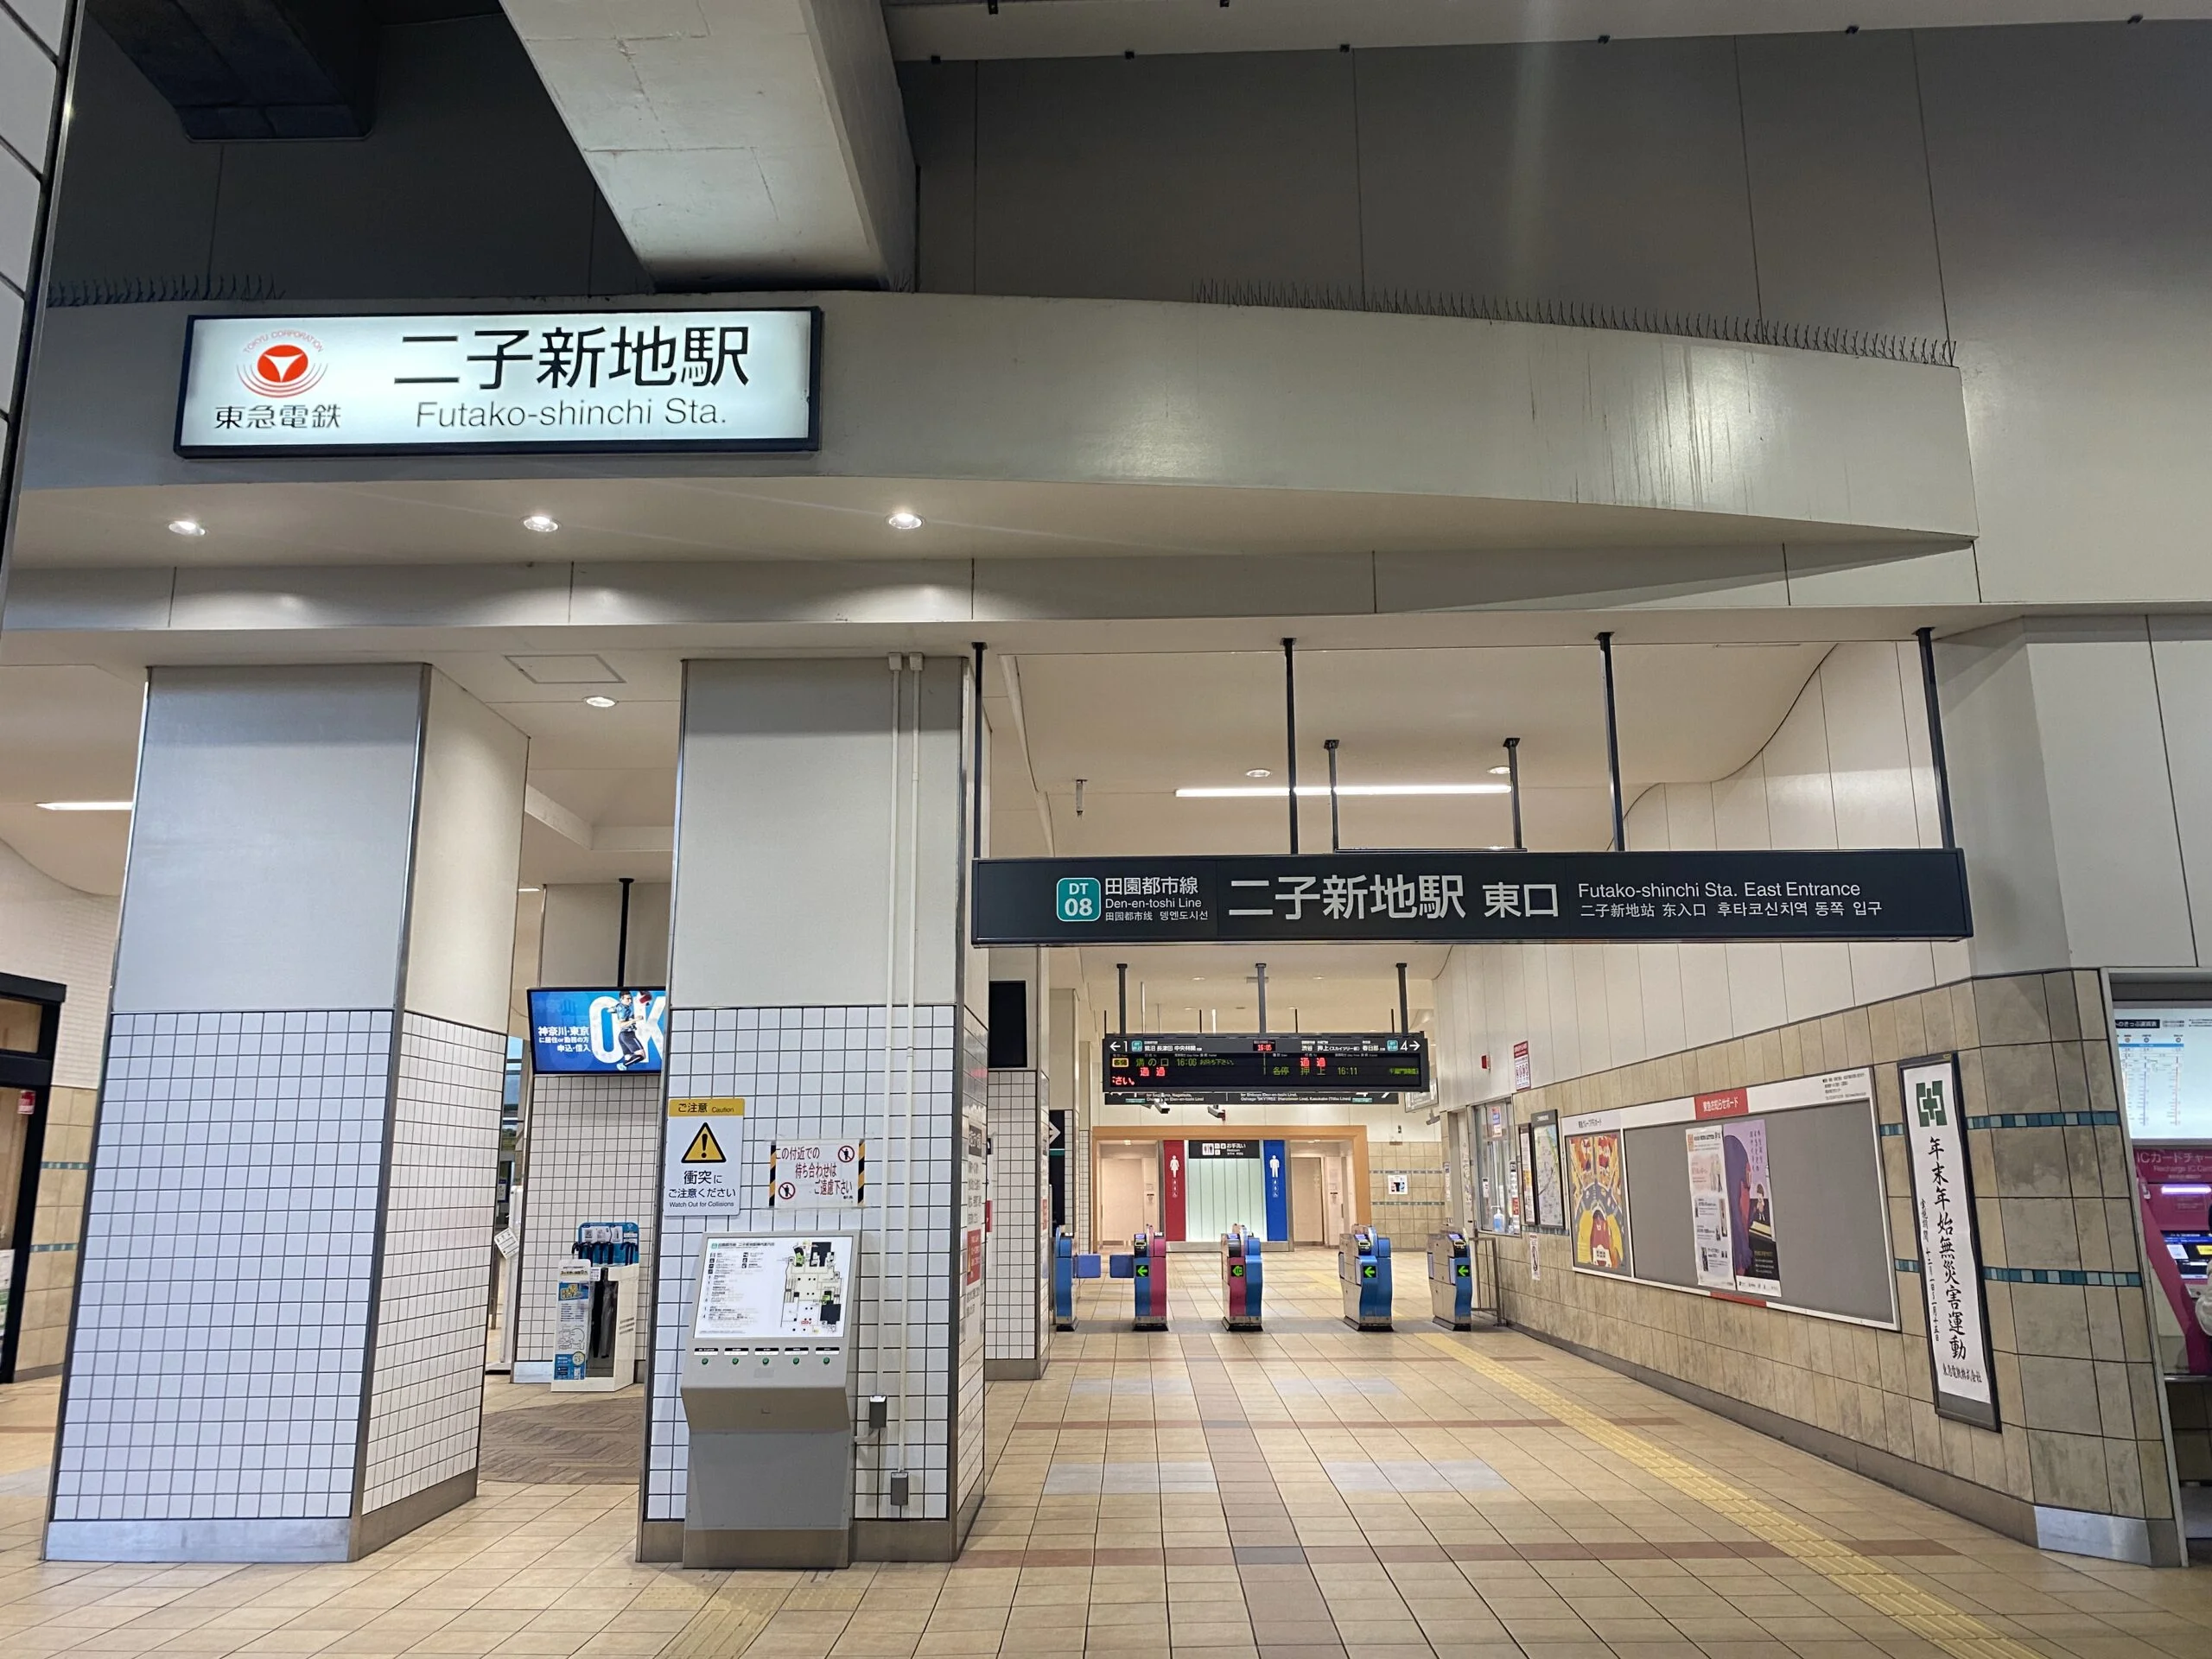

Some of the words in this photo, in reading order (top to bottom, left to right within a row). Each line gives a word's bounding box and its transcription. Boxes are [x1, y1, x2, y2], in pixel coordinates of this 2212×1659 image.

[243, 334, 269, 353] TOKYU
[270, 329, 324, 353] CORPORATION
[394, 326, 750, 391] 二子新地駅
[213, 404, 341, 429] 東急電鉄
[416, 397, 652, 428] Futako-shinchi
[664, 397, 727, 424] Sta.
[1069, 883, 1089, 895] DT
[1104, 876, 1199, 895] 田園都市線
[1578, 882, 1700, 898] Futako-shinchi
[1705, 882, 1738, 897] Sta.
[1745, 882, 1782, 897] East
[1786, 882, 1860, 896] Entrance
[1105, 898, 1175, 909] Den-en-toshi
[1179, 898, 1202, 908] Line
[1229, 874, 1466, 921] 二子新地駅
[1482, 881, 1559, 918] 東口
[1064, 898, 1093, 917] 08
[1580, 903, 1655, 918] 二子新地站
[1662, 903, 1706, 918] 东入口
[1717, 901, 1808, 917] 후타코신치역
[1815, 901, 1845, 917] 동쪽
[1853, 901, 1883, 917] 입구
[1400, 1040, 1408, 1052] 4
[678, 1103, 708, 1113] ご注意
[683, 1170, 723, 1185] 衝突に
[795, 1162, 837, 1179] 待ち合わせは
[668, 1188, 736, 1198] ご注意ください
[814, 1179, 853, 1196] ご遠慮下さい
[1928, 1136, 1967, 1361] 年末年始無災害運動
